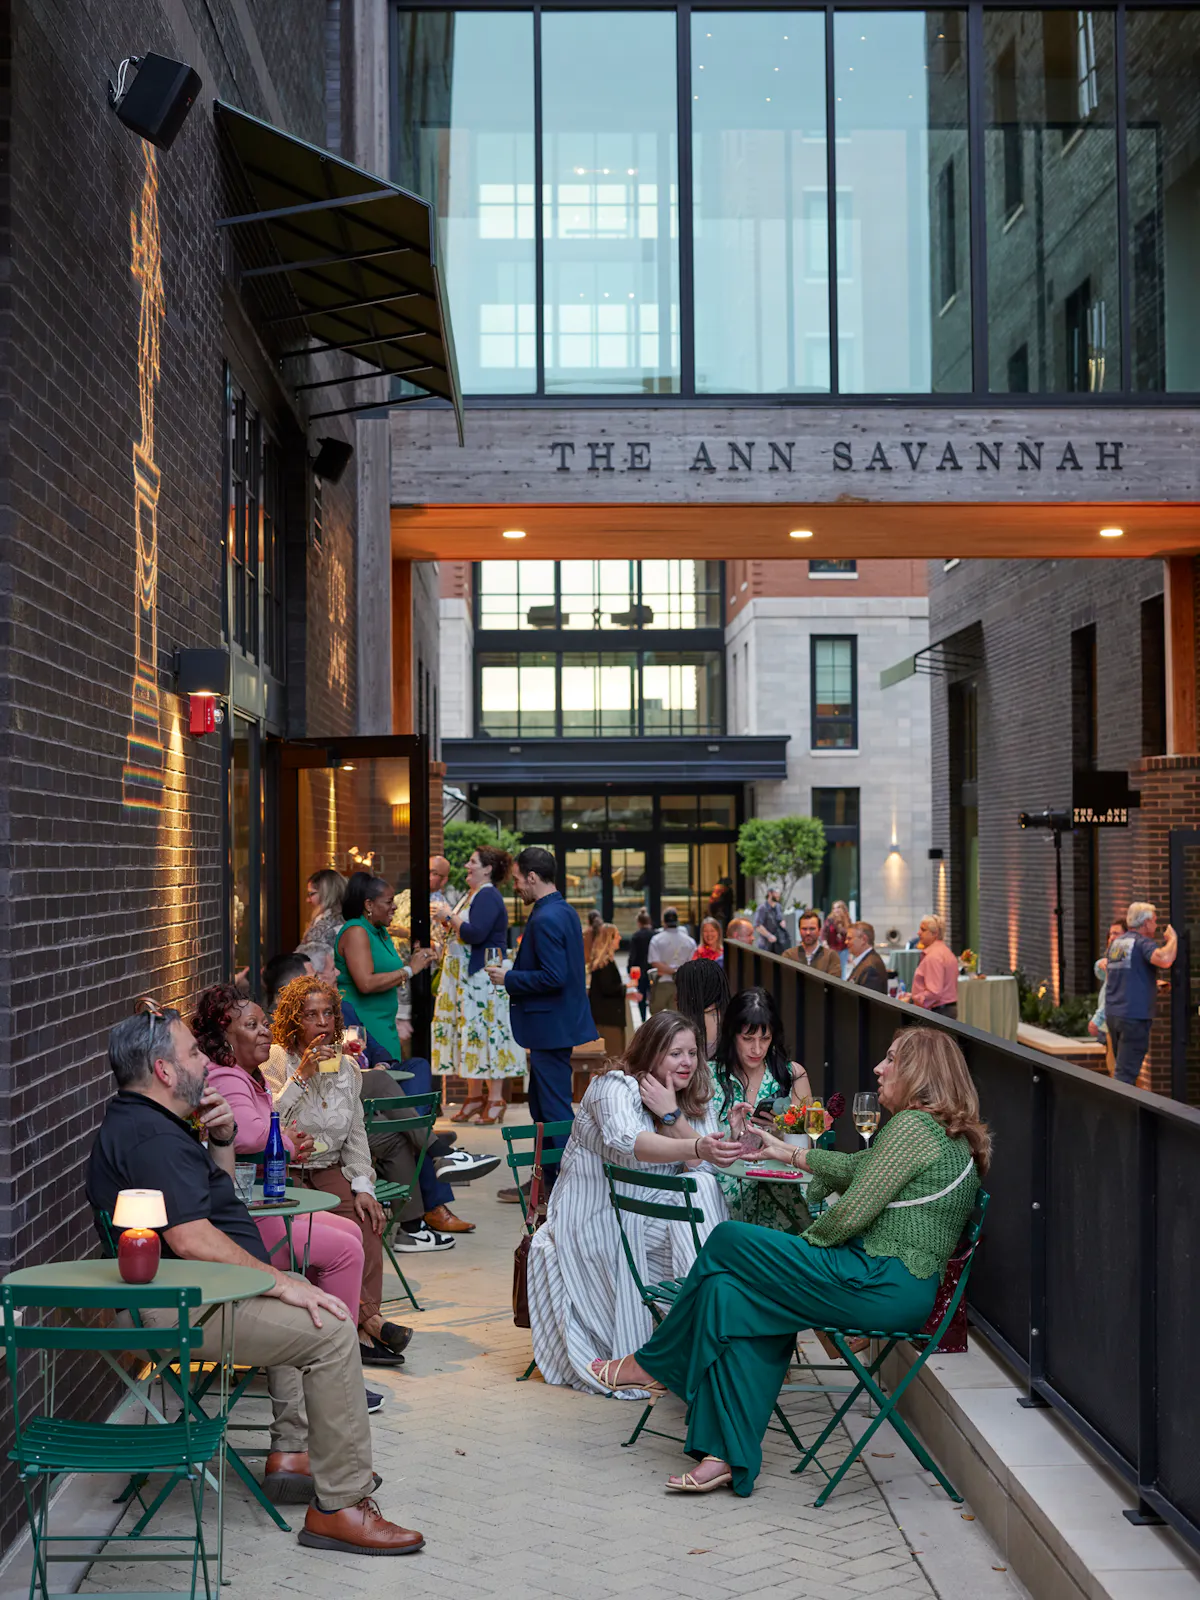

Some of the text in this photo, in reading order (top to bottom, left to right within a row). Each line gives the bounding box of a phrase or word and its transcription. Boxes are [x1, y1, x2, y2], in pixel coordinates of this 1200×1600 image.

[551, 441, 1124, 472] THE ANN SAVANNAH
[1074, 808, 1127, 816] THE ANN
[1074, 815, 1127, 823] SAVANNAH
